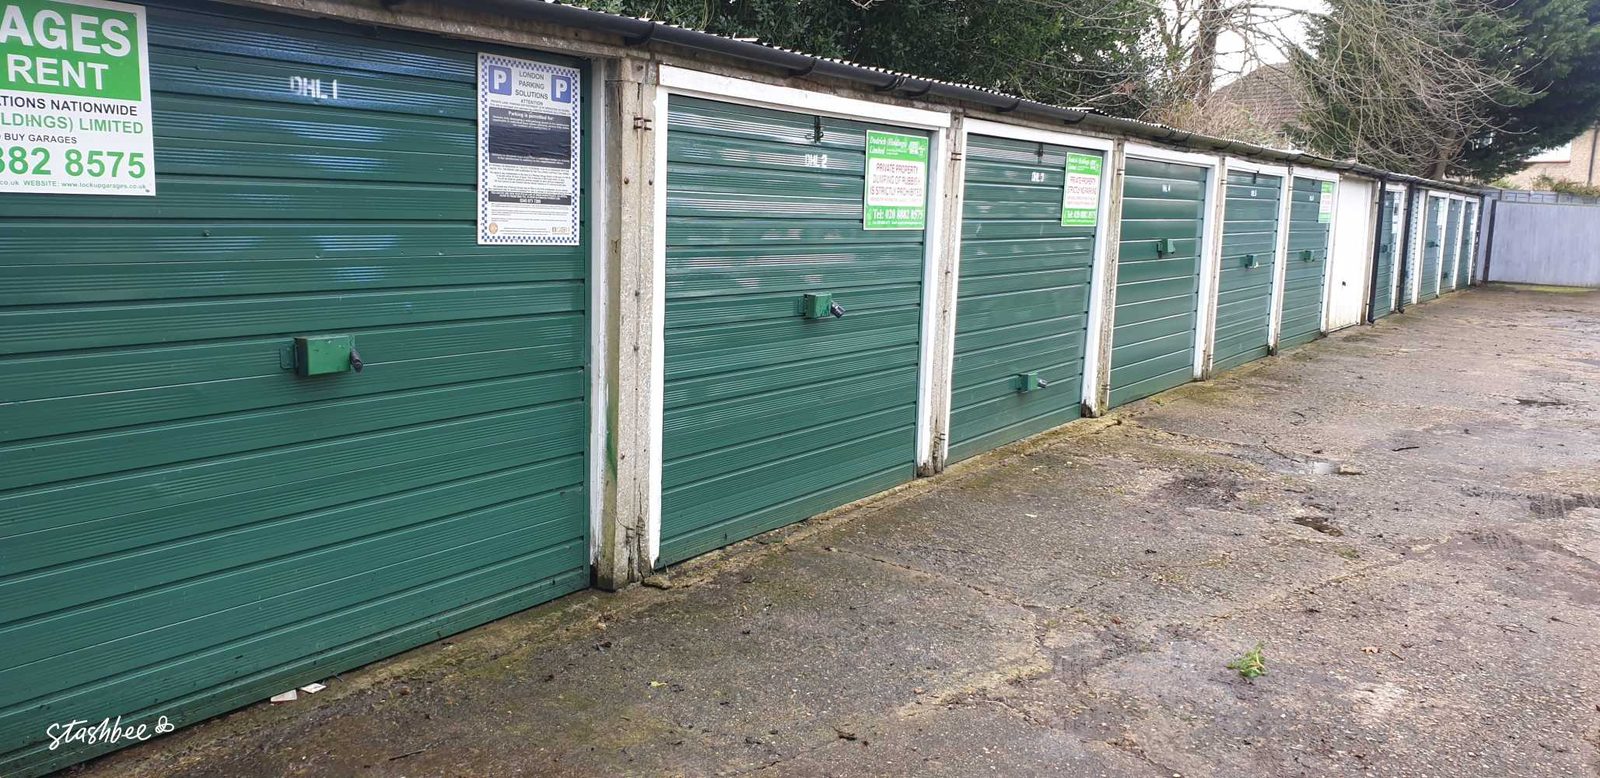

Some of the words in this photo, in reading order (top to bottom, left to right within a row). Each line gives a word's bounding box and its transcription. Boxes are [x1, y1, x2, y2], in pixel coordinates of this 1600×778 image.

[0, 5, 131, 58] AGES
[7, 53, 109, 90] RENT
[493, 69, 507, 90] P
[519, 71, 544, 80] LONDON
[290, 75, 328, 99] DHL
[515, 89, 549, 100] SOLUTIONS
[518, 80, 545, 90] PARKING
[555, 79, 568, 99] P
[0, 95, 46, 109] TIONS
[51, 99, 138, 116] NATIONWIDE
[1, 112, 73, 133] LDINGS)
[79, 118, 144, 134] LIMITED
[4, 132, 25, 141] BUY
[28, 134, 77, 144] GARAGES
[65, 149, 146, 178] 8575
[876, 162, 895, 173] PRIVATE
[896, 164, 919, 174] PROPERTY
